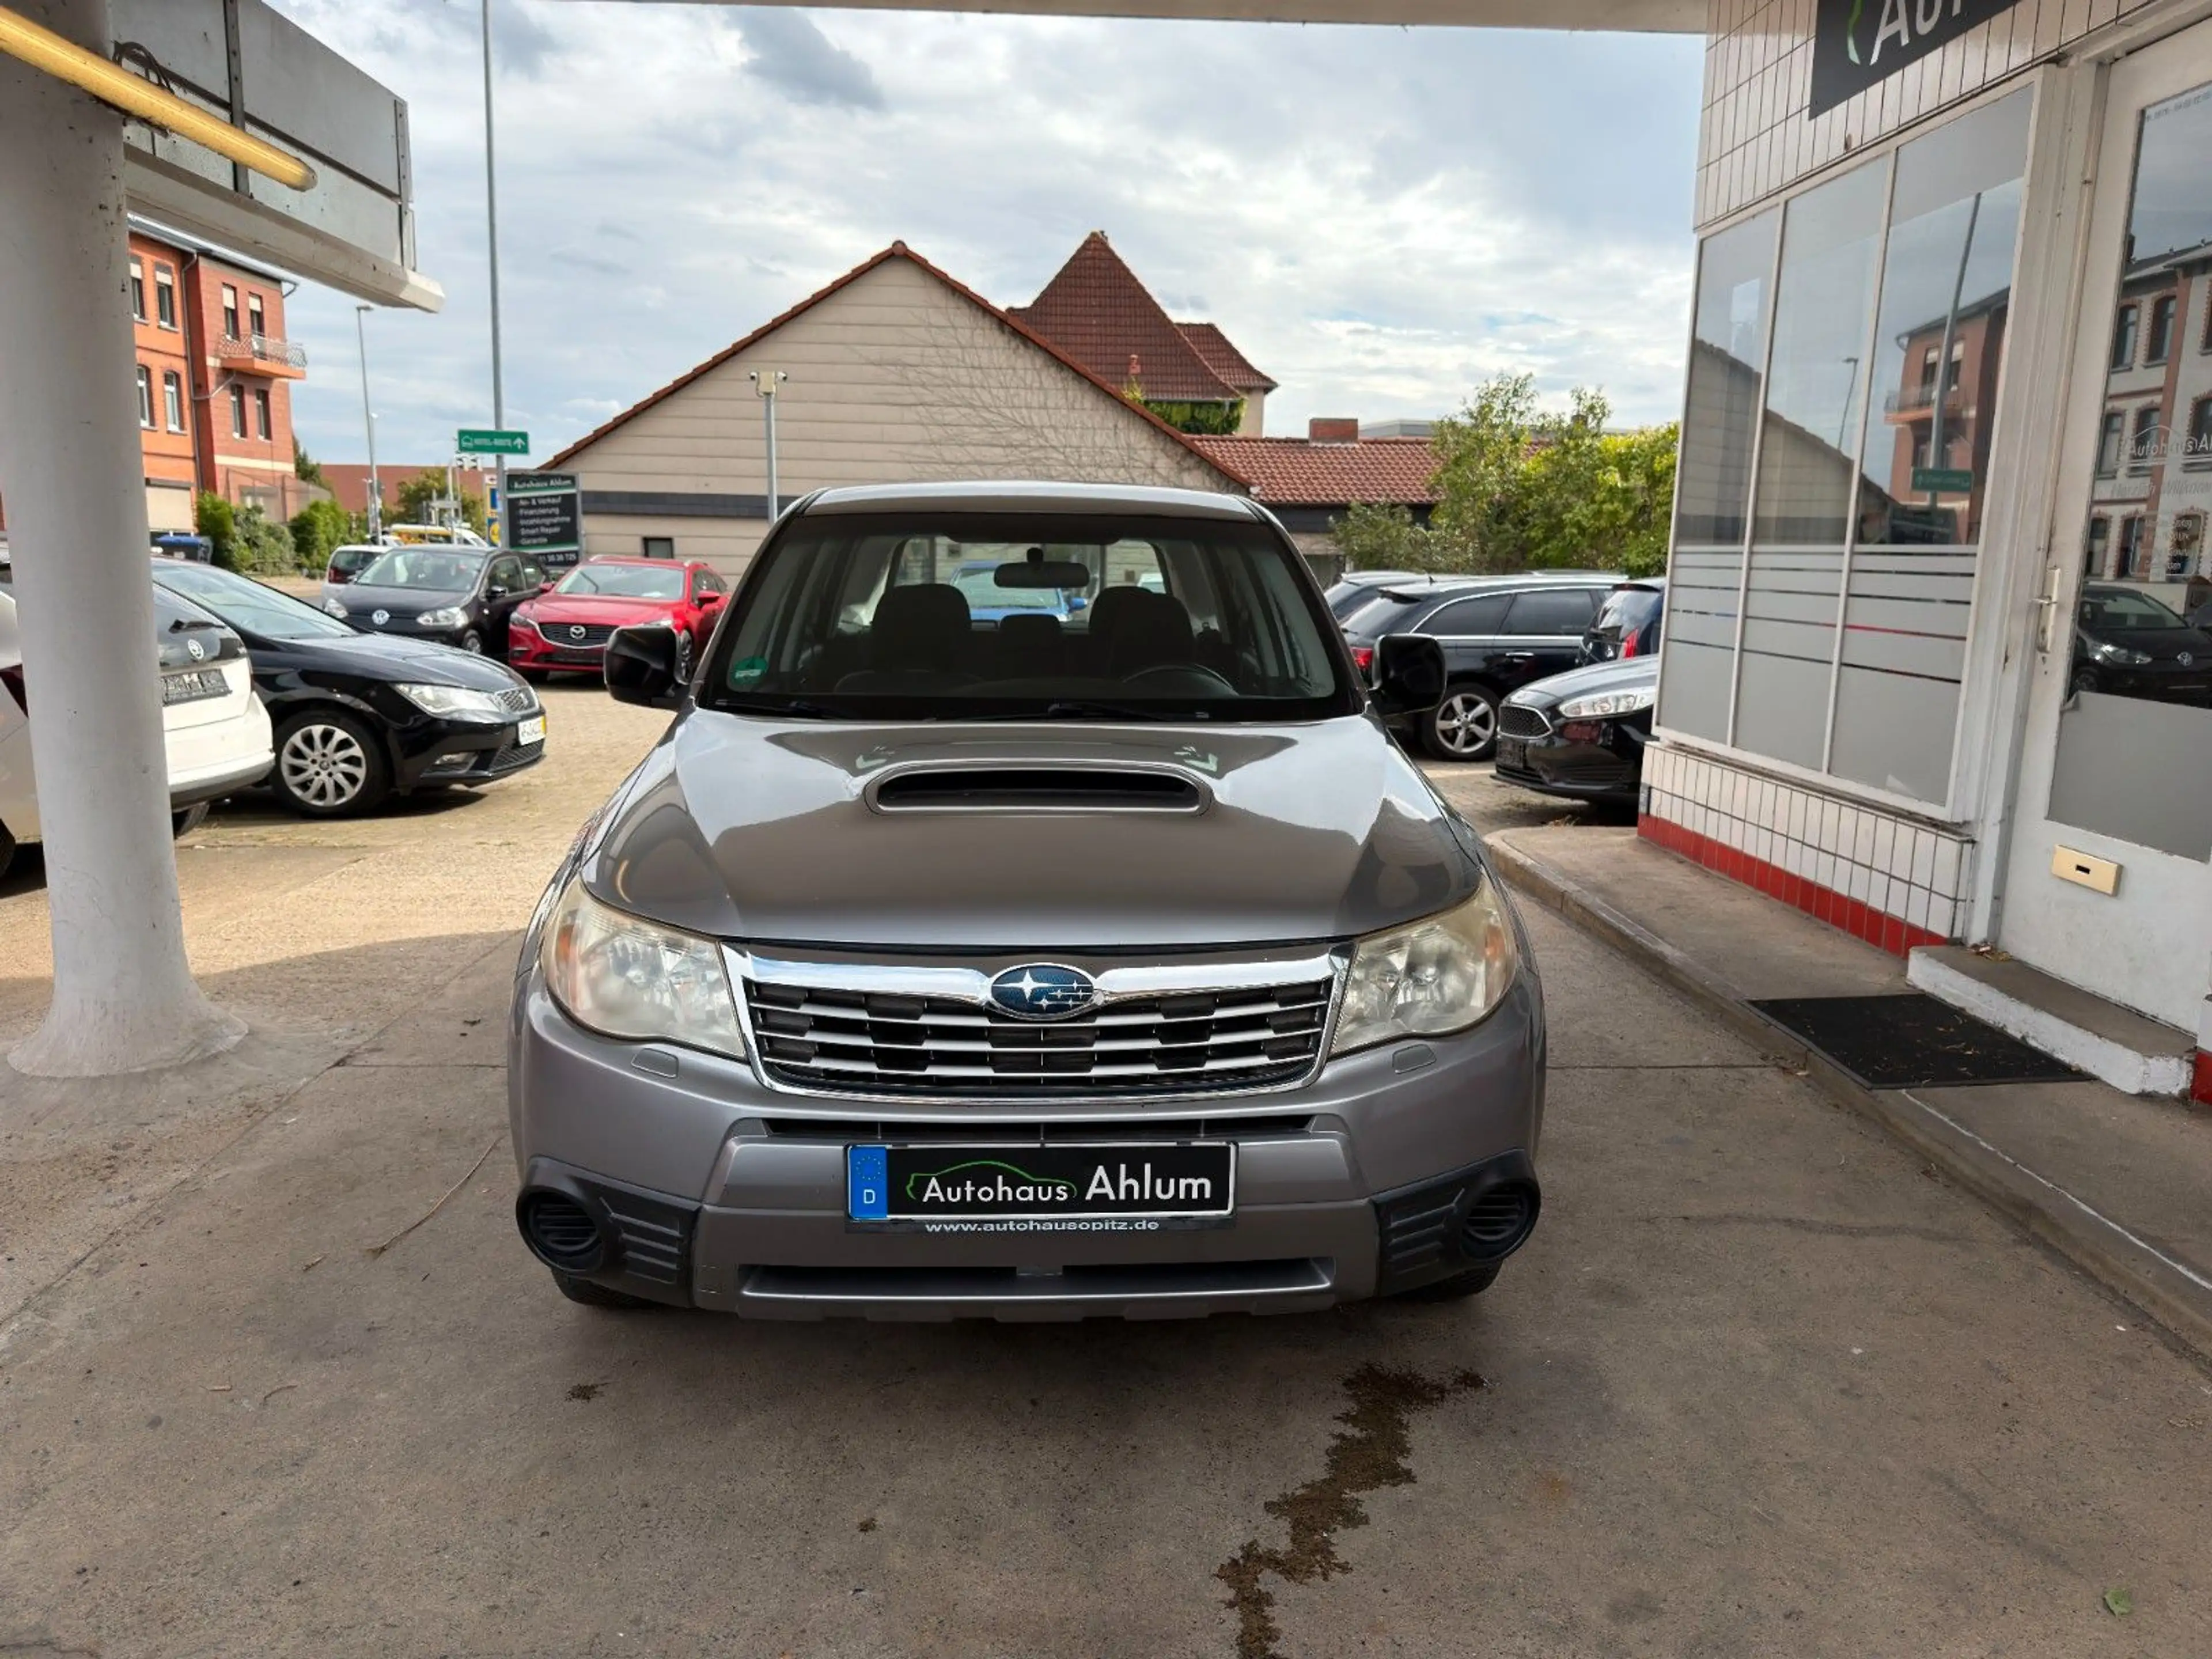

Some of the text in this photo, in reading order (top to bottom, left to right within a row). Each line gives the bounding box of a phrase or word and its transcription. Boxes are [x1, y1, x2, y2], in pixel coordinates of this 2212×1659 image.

[1870, 0, 1961, 66] Au
[2128, 434, 2194, 457] Autohaus
[513, 478, 572, 488] Autohaus Ahlum
[537, 496, 562, 505] Verkauf
[518, 507, 559, 516] Finanzierung
[520, 526, 561, 535] Smart Repair
[520, 537, 548, 546] Garantie
[922, 1162, 1211, 1203] Autohaus Ahlum
[863, 1188, 876, 1204] D
[925, 1218, 1160, 1232] www.autohausopitz.de
